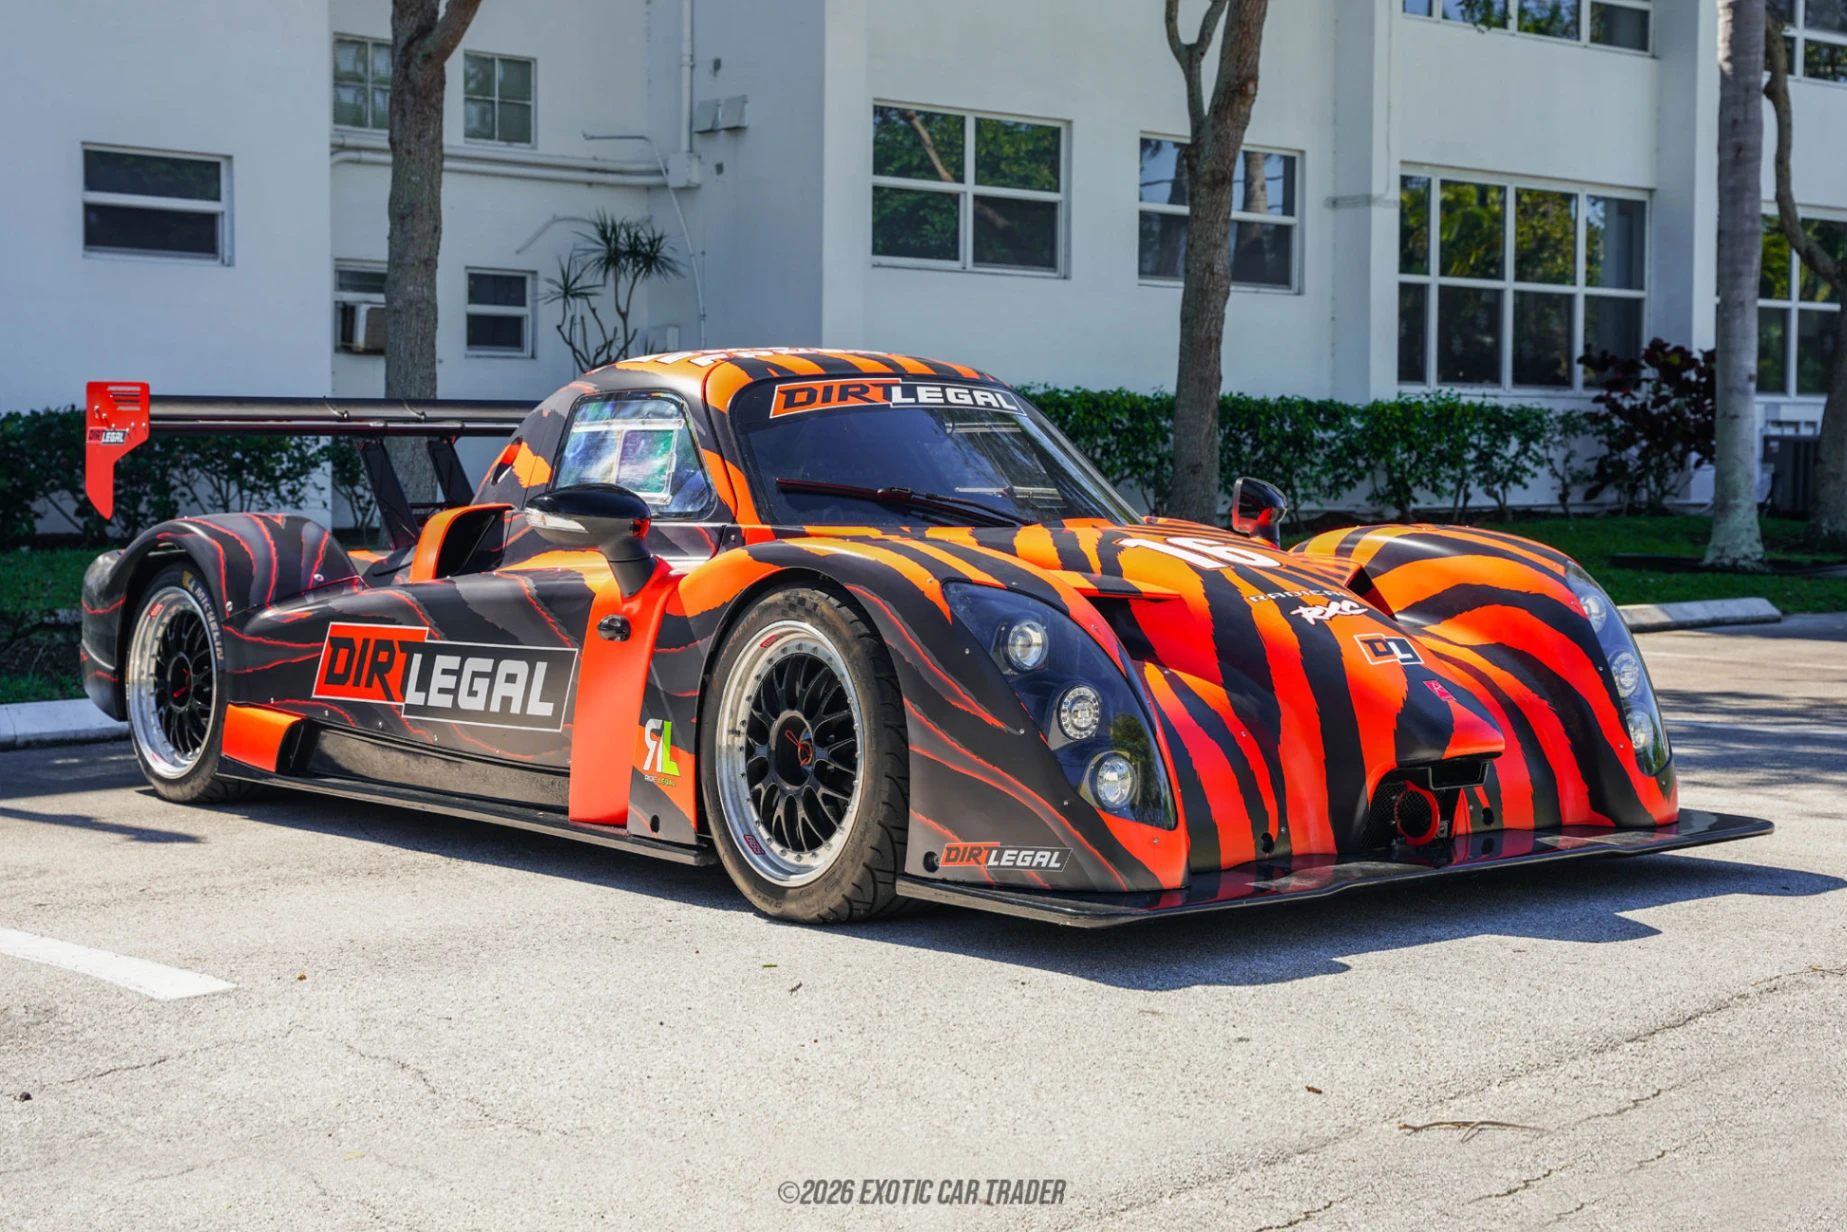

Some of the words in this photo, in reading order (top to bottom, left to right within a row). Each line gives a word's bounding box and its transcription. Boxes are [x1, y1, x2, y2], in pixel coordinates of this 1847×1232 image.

[1114, 536, 1284, 570] 16
[1248, 589, 1356, 603] RADICAL
[194, 587, 224, 661] MICHELIN
[1289, 599, 1369, 626] RXC
